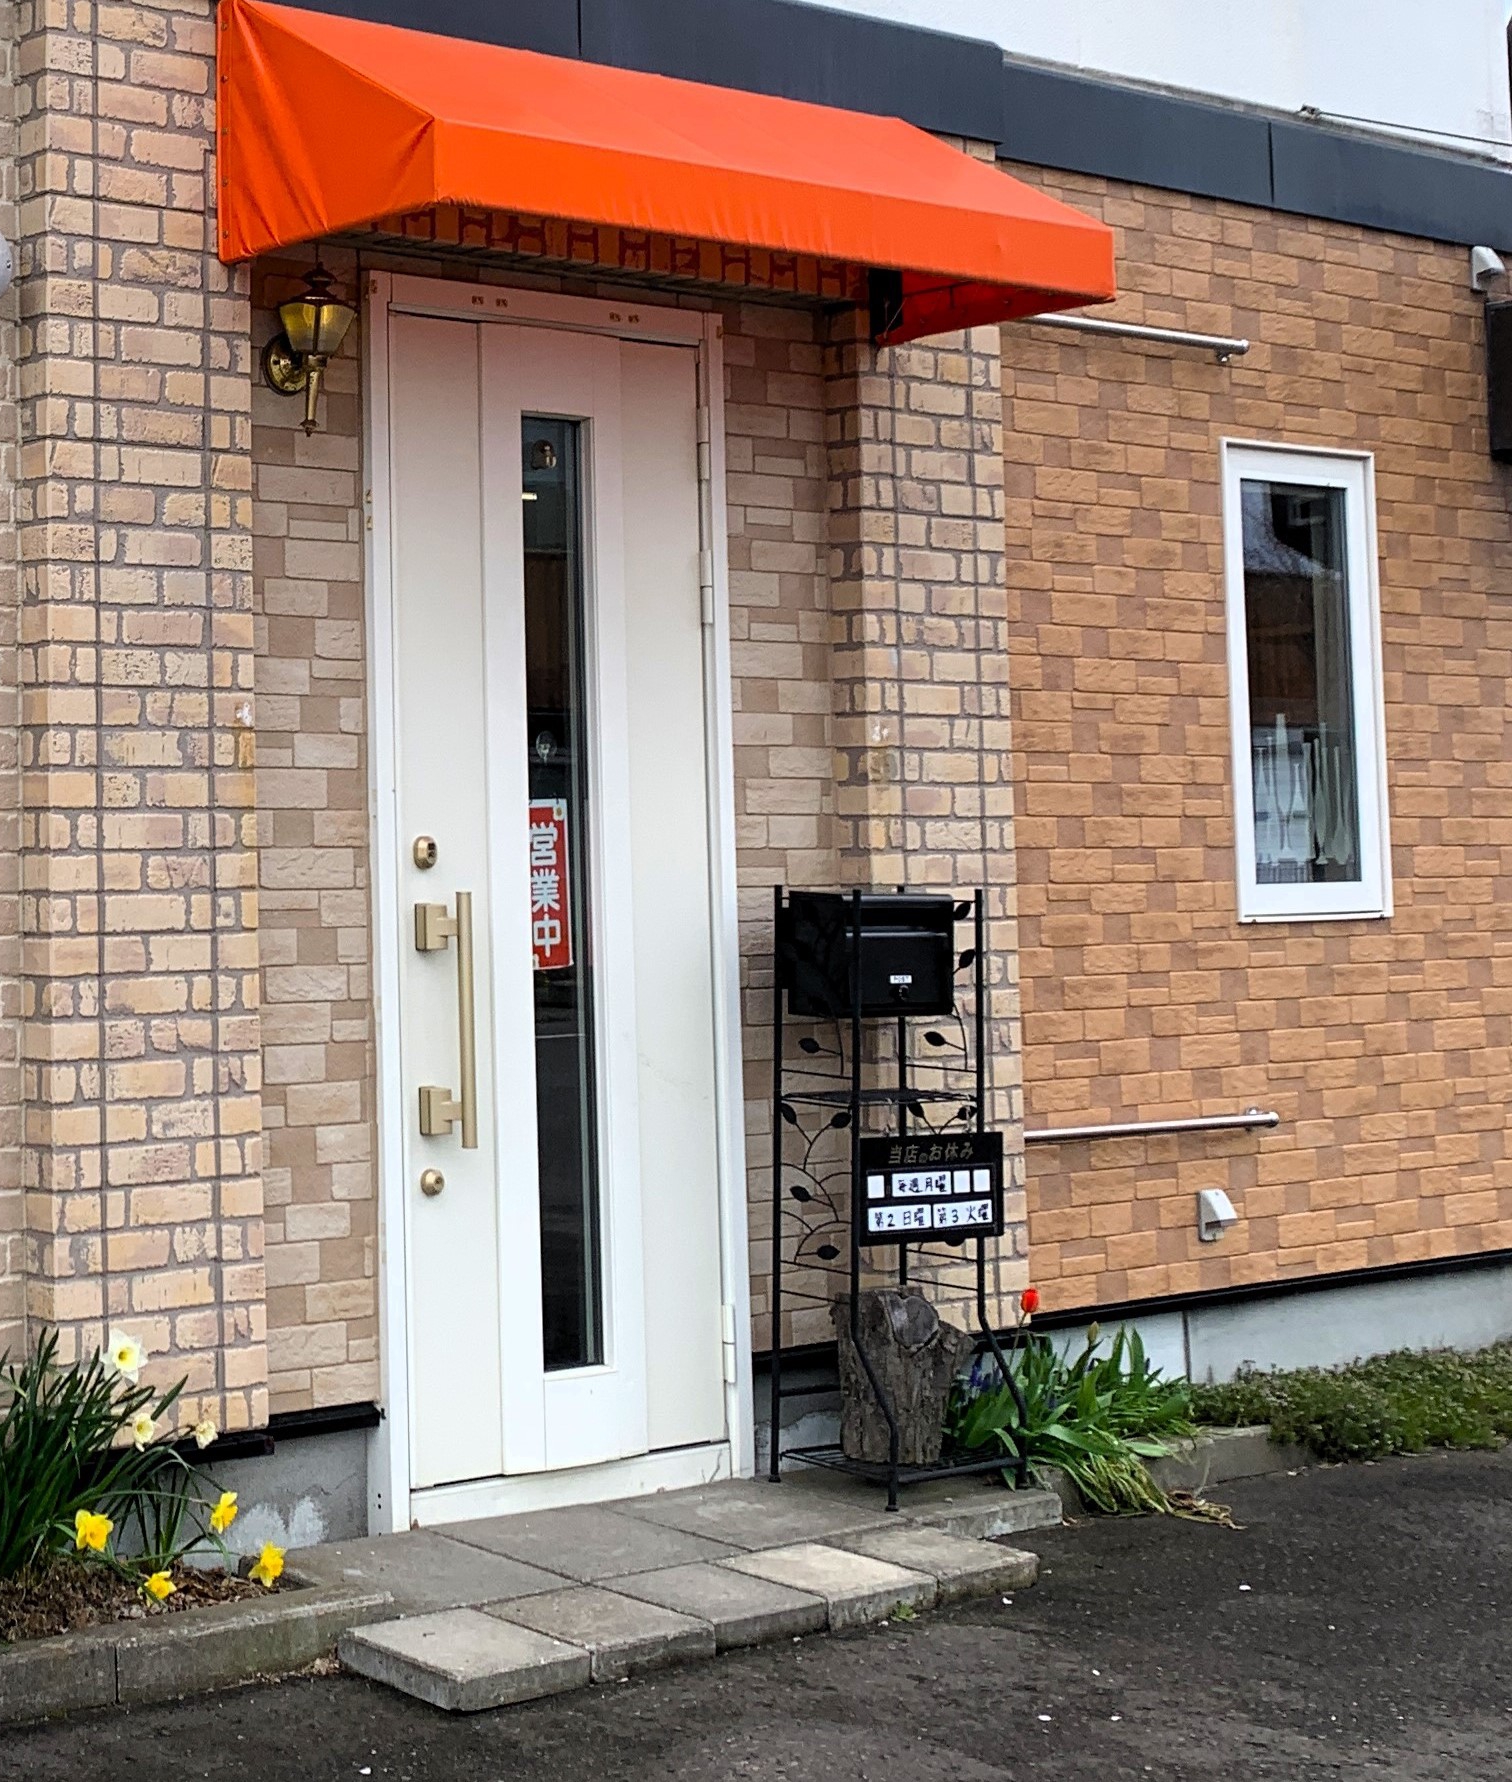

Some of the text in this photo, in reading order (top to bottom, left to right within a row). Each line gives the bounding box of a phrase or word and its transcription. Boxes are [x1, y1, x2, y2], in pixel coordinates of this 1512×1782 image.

[530, 821, 561, 958] 営業中
[888, 1141, 974, 1164] 当店のお休み
[898, 1174, 947, 1193] 毎週月曜
